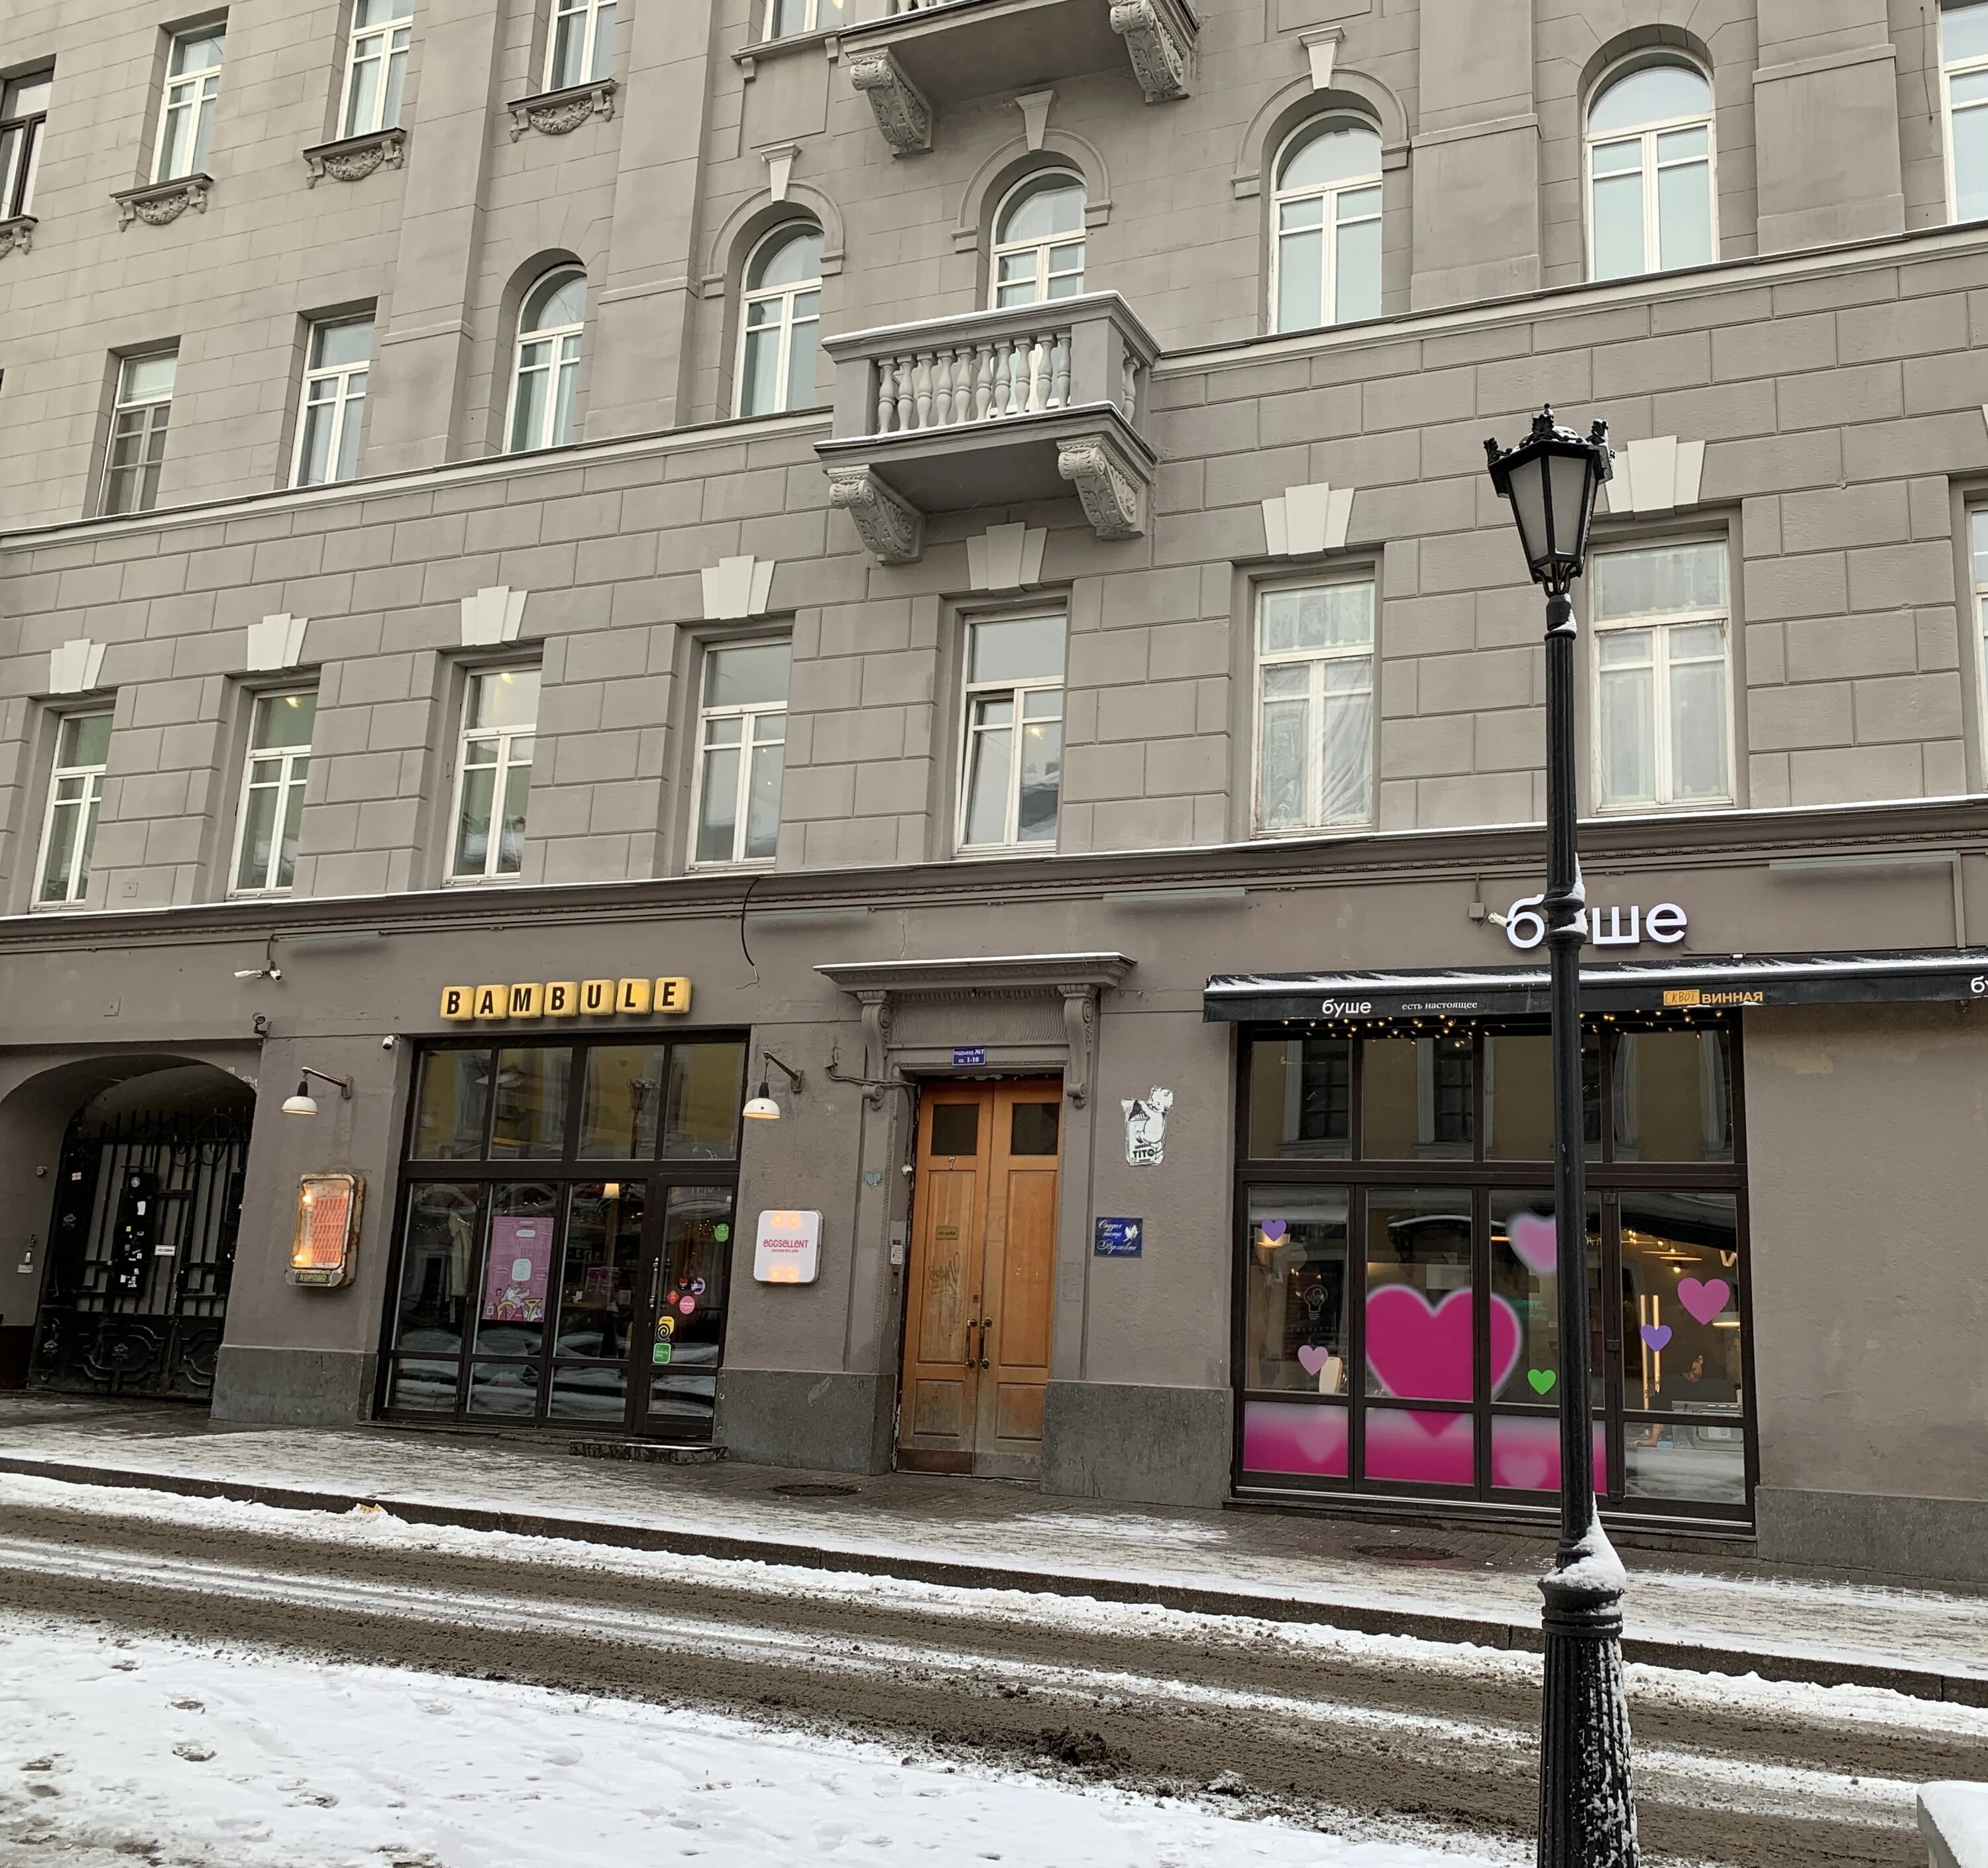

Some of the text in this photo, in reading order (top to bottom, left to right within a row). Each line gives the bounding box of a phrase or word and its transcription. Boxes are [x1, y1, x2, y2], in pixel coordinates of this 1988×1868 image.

[1506, 893, 1688, 949] бше
[446, 981, 677, 1015] BAMBULE
[1664, 990, 1763, 1005] СКВОТ ВИННАЯ
[1321, 998, 1372, 1017] буше
[1402, 1000, 1478, 1011] есть настоящее
[1132, 1148, 1155, 1158] TITO
[948, 1156, 957, 1170] 7
